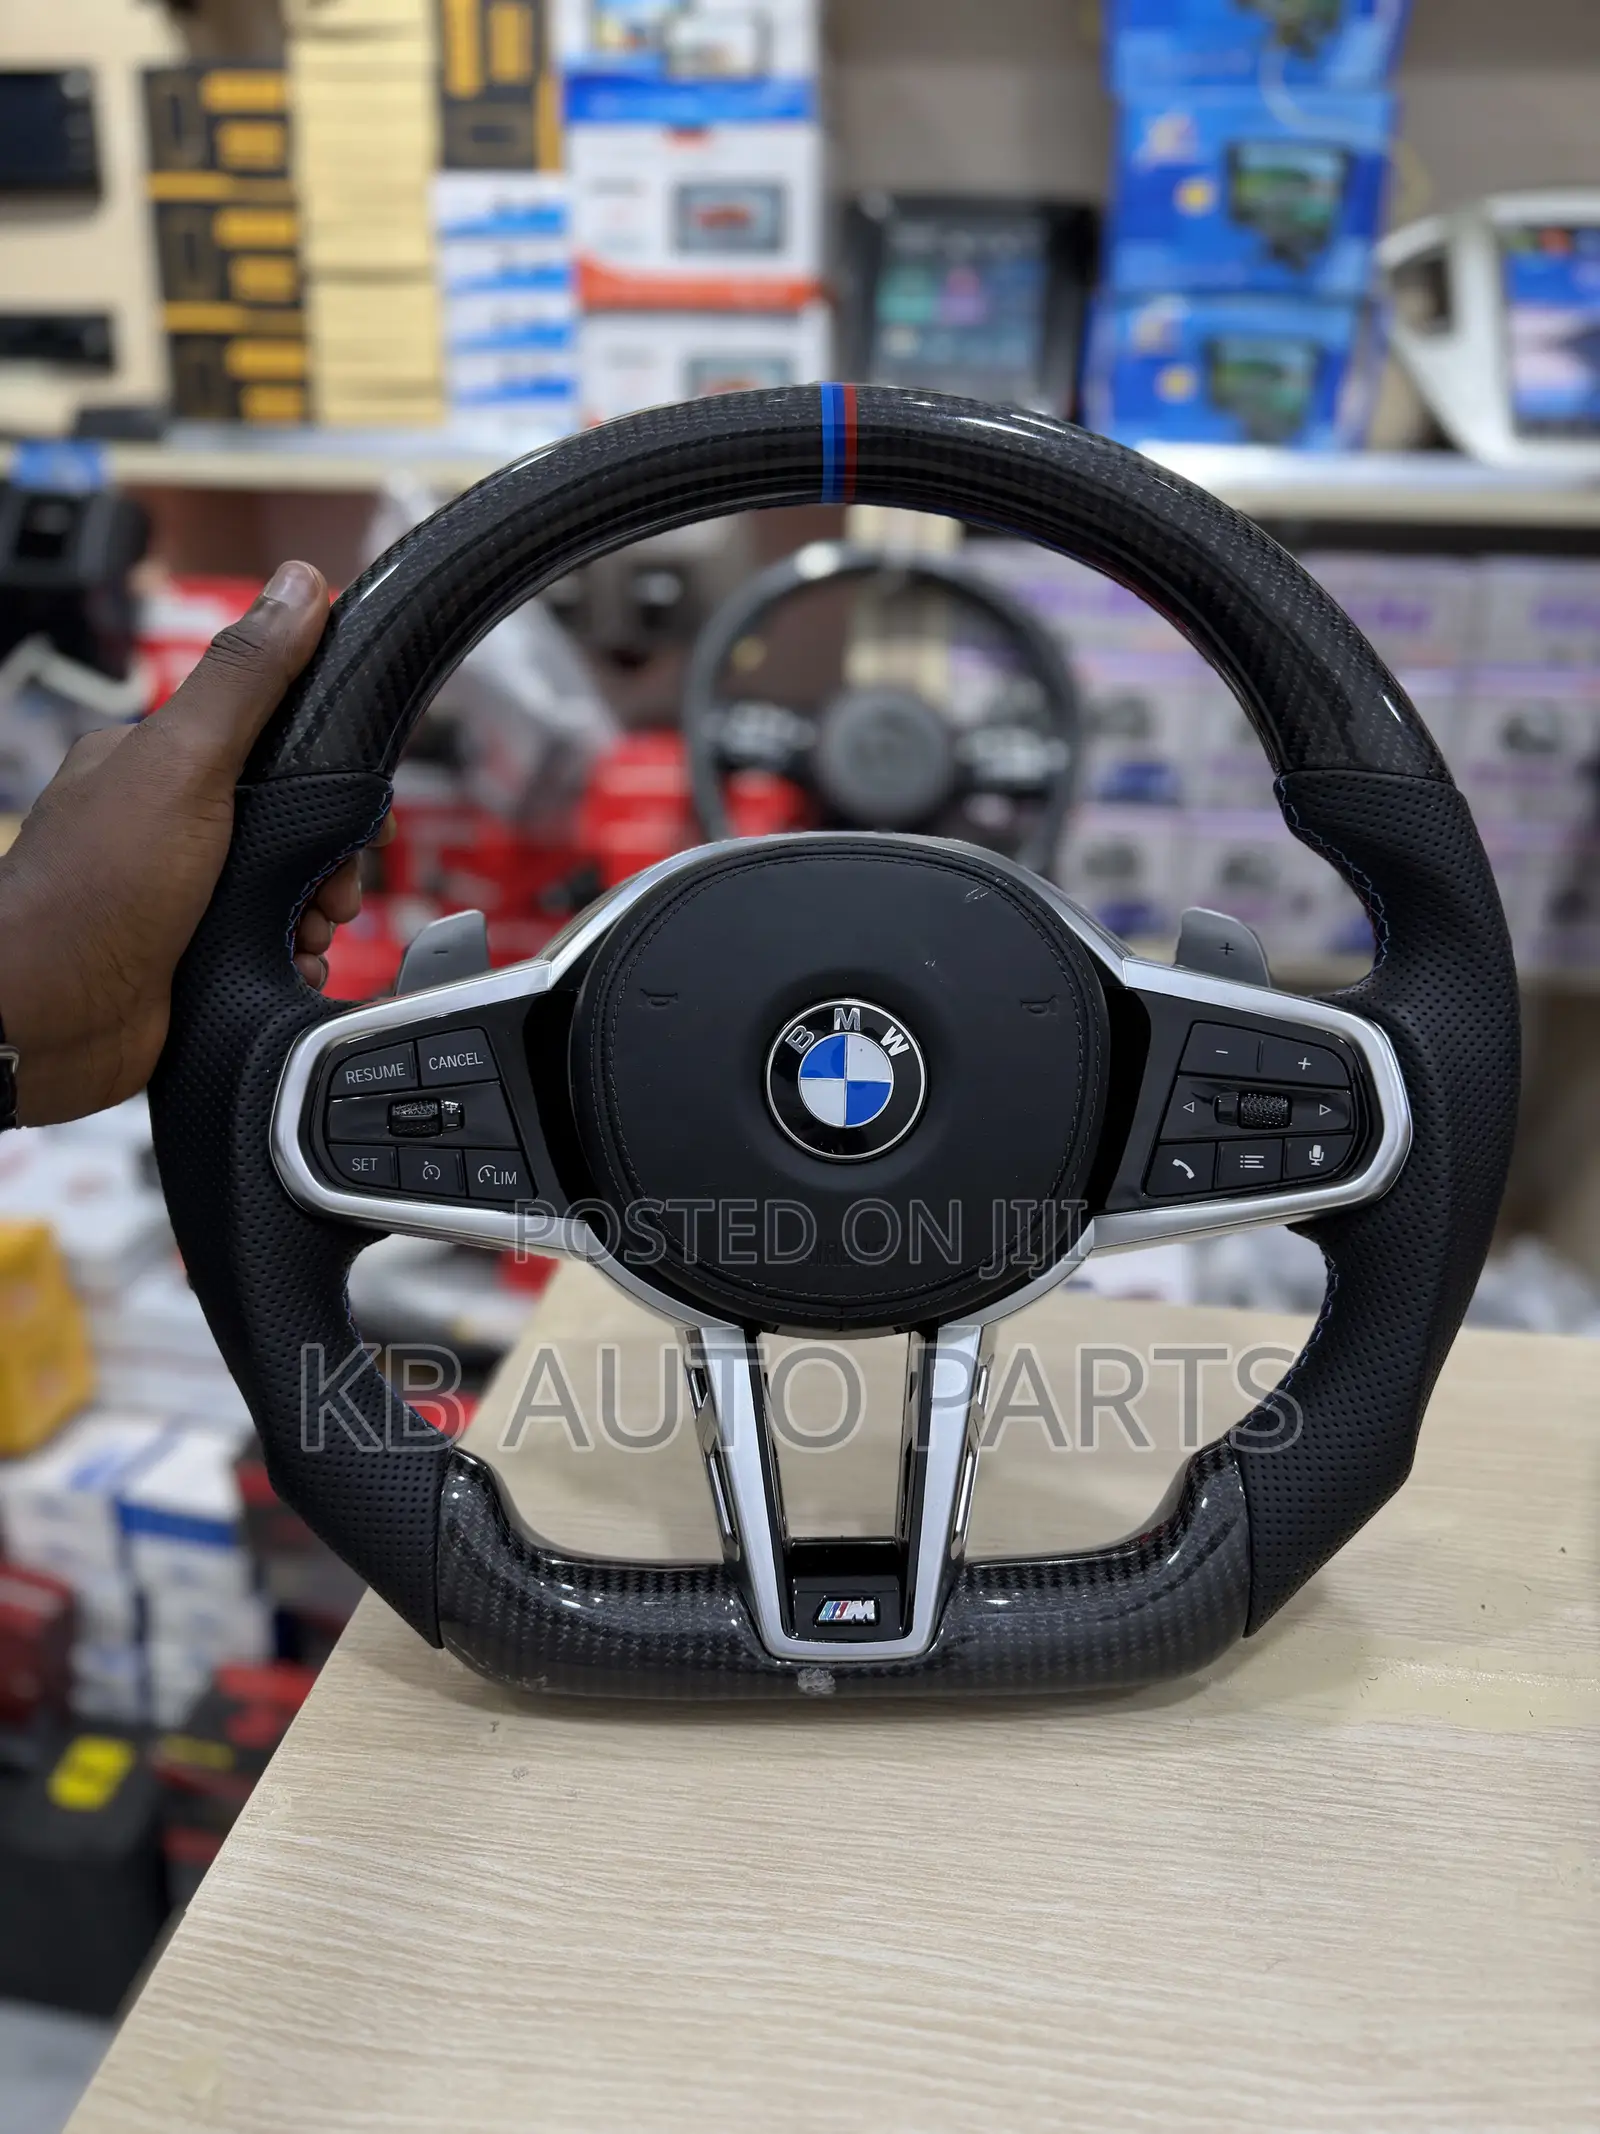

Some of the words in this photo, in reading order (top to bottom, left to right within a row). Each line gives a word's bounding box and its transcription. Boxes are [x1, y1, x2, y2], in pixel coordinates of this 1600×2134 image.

[785, 1007, 910, 1057] BMW
[428, 1052, 483, 1070] CANCEL
[345, 1062, 405, 1084] RESUME
[352, 1158, 378, 1171] SET
[493, 1171, 517, 1185] LIM
